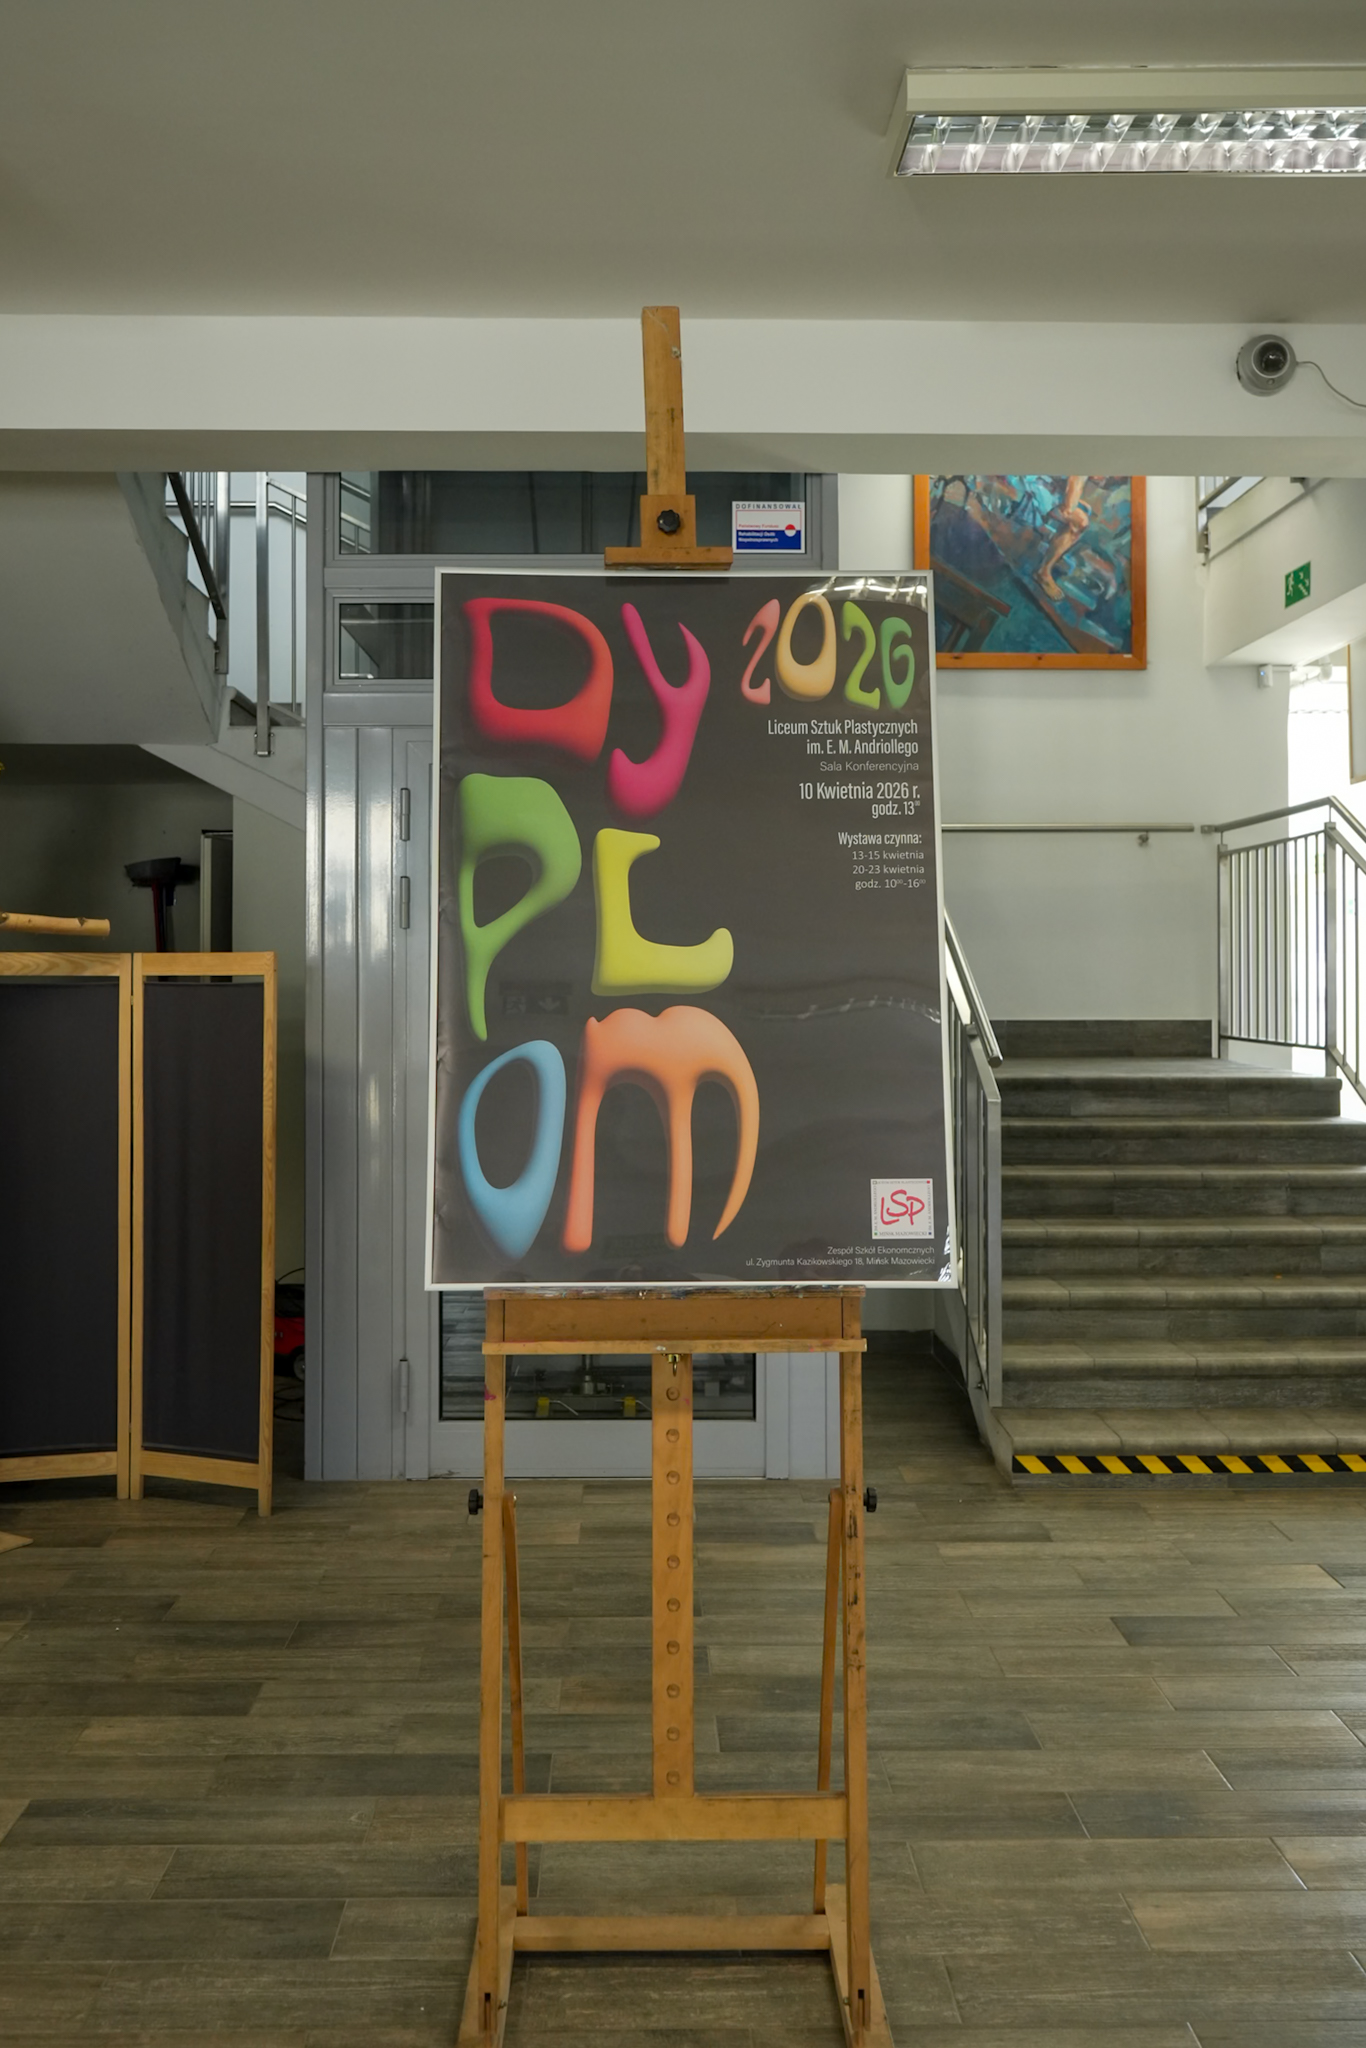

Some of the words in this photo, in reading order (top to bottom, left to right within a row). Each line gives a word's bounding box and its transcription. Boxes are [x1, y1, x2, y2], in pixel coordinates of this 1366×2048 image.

[740, 593, 915, 709] 2026
[768, 719, 808, 735] Liceum
[811, 719, 842, 735] Sztuk
[844, 719, 918, 737] Plastycznych
[806, 739, 824, 755] im.
[826, 739, 836, 754] E.
[839, 739, 852, 754] M.
[854, 738, 919, 757] Andriollego
[820, 761, 842, 771] Sala
[845, 760, 919, 773] Konferencyjna
[799, 782, 813, 799] 10
[816, 782, 873, 799] Kwietnia
[876, 782, 909, 799] 2026
[912, 785, 921, 799] r.
[871, 801, 902, 819] godz.
[838, 832, 882, 848] Wystawa
[884, 833, 922, 847] czynna:
[852, 851, 880, 860] 13-15
[882, 850, 925, 860] kwietnia
[852, 865, 881, 874] 20-23
[883, 864, 925, 874] kwietnia
[855, 878, 881, 890] godz.
[880, 1189, 925, 1225] LSP
[827, 1246, 854, 1255] Zespół
[855, 1246, 876, 1254] Szkół
[745, 1257, 755, 1266] ul.
[756, 1257, 795, 1267] Zygmunta
[796, 1256, 853, 1267] Kazikowskiego
[854, 1257, 864, 1266] 18,
[866, 1256, 889, 1265] Mińsk
[891, 1256, 936, 1265] Mazowiecki
